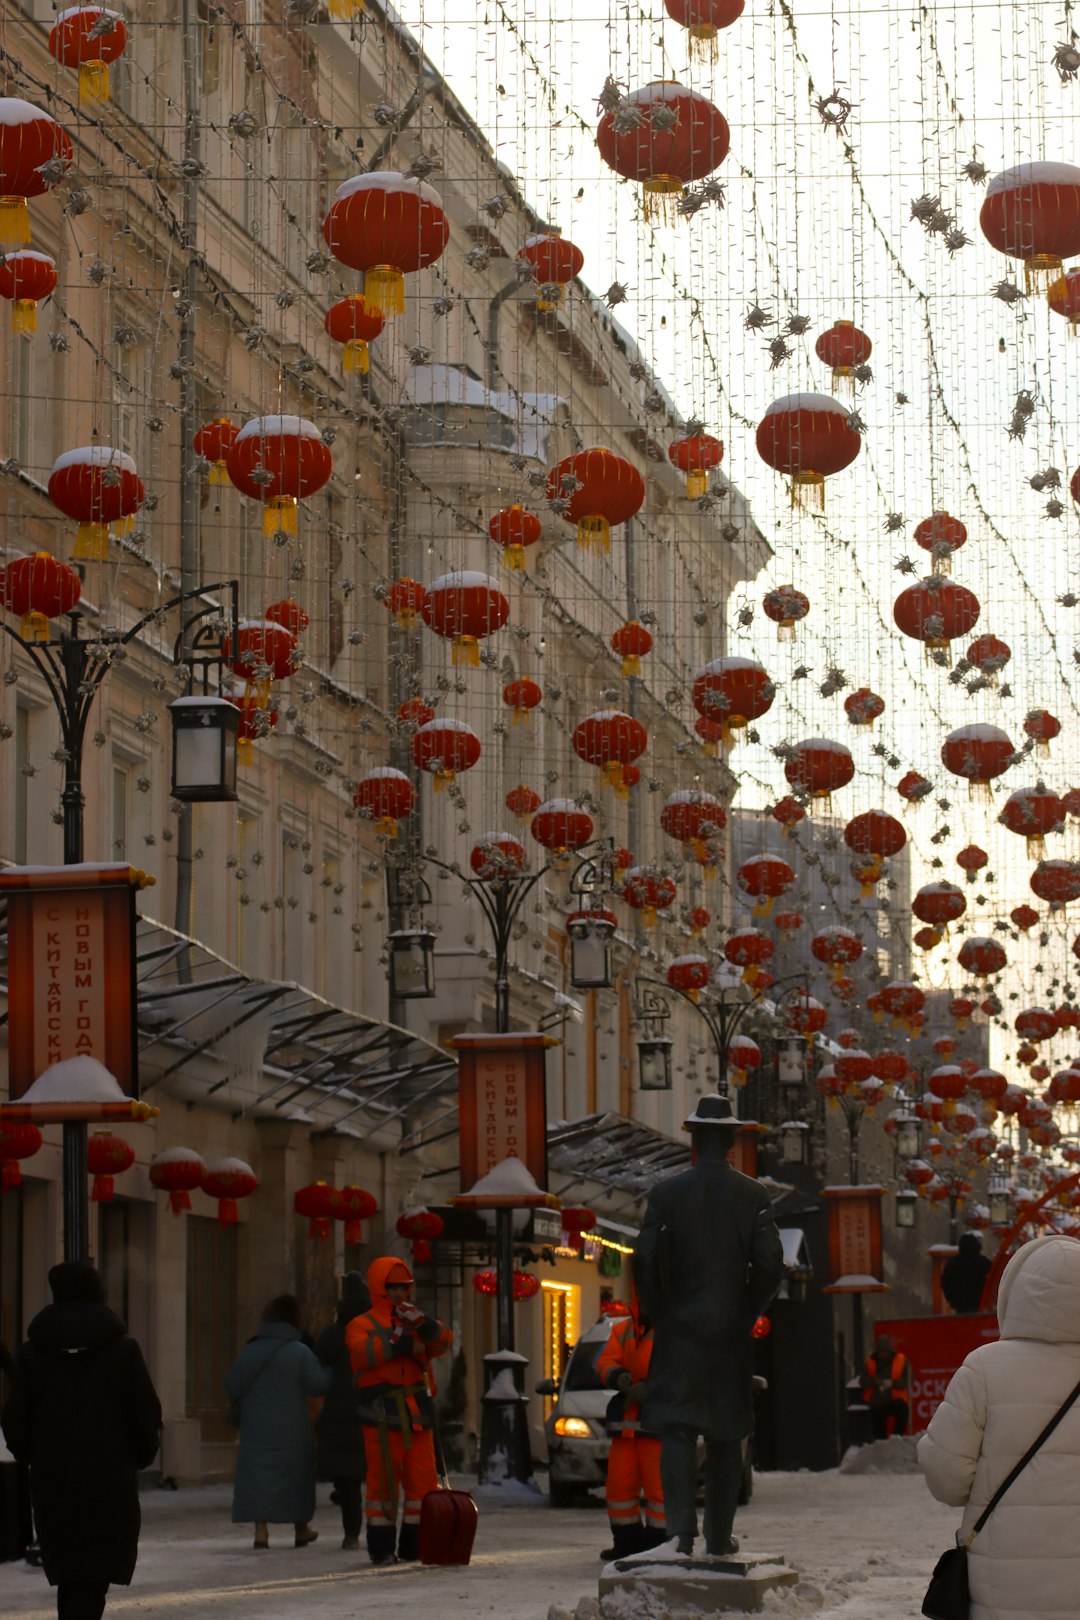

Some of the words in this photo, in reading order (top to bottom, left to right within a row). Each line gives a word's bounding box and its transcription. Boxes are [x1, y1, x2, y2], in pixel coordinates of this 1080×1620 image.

[46, 908, 60, 921] С
[74, 907, 92, 988] НОВЫМ
[47, 932, 61, 1066] КИТАЙСКИ
[505, 1061, 518, 1118] НОВЫМ
[486, 1079, 497, 1170] КИТАЙСКИ
[506, 1124, 519, 1159] ГОД
